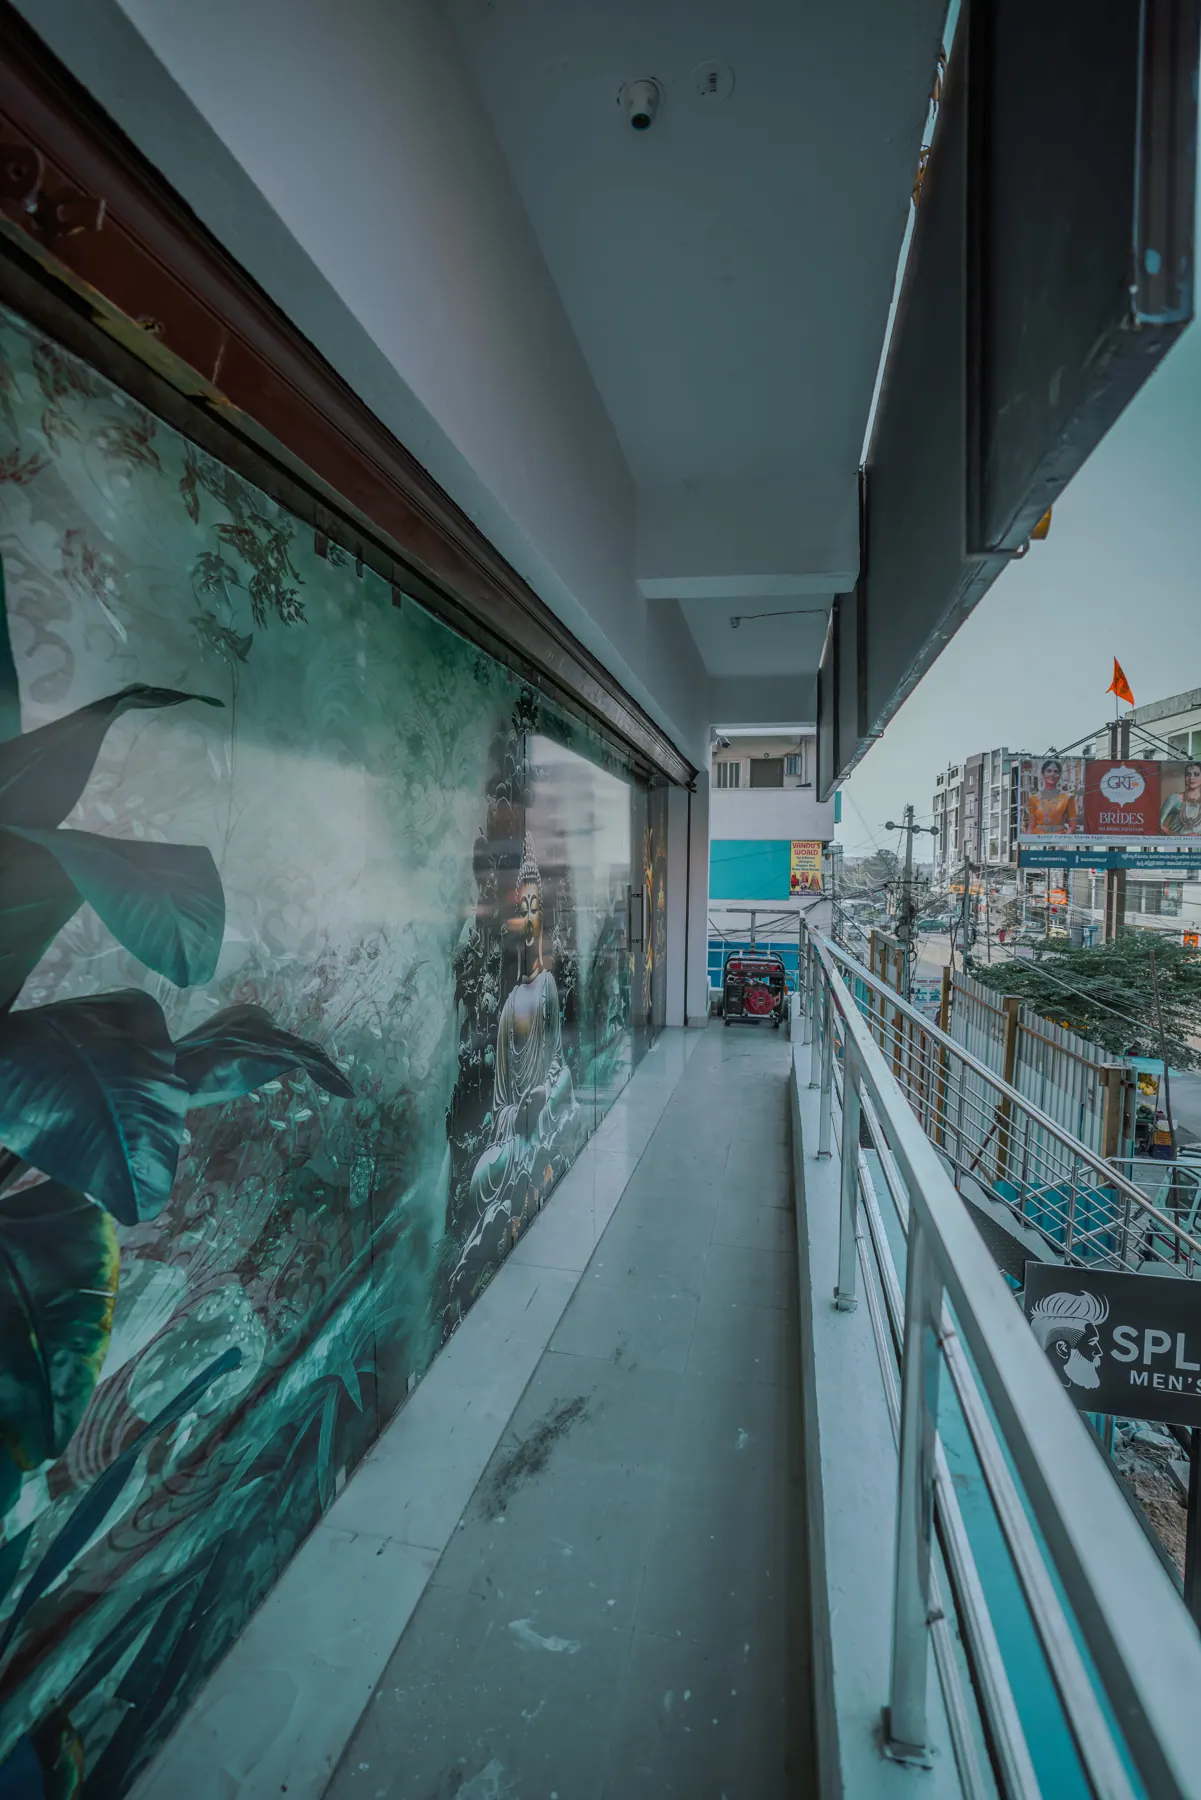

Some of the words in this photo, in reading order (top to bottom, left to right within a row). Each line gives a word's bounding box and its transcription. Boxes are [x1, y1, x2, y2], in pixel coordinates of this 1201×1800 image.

[1107, 775, 1135, 790] GRT
[1099, 811, 1144, 825] BRIDES
[1110, 1325, 1200, 1372] SPL
